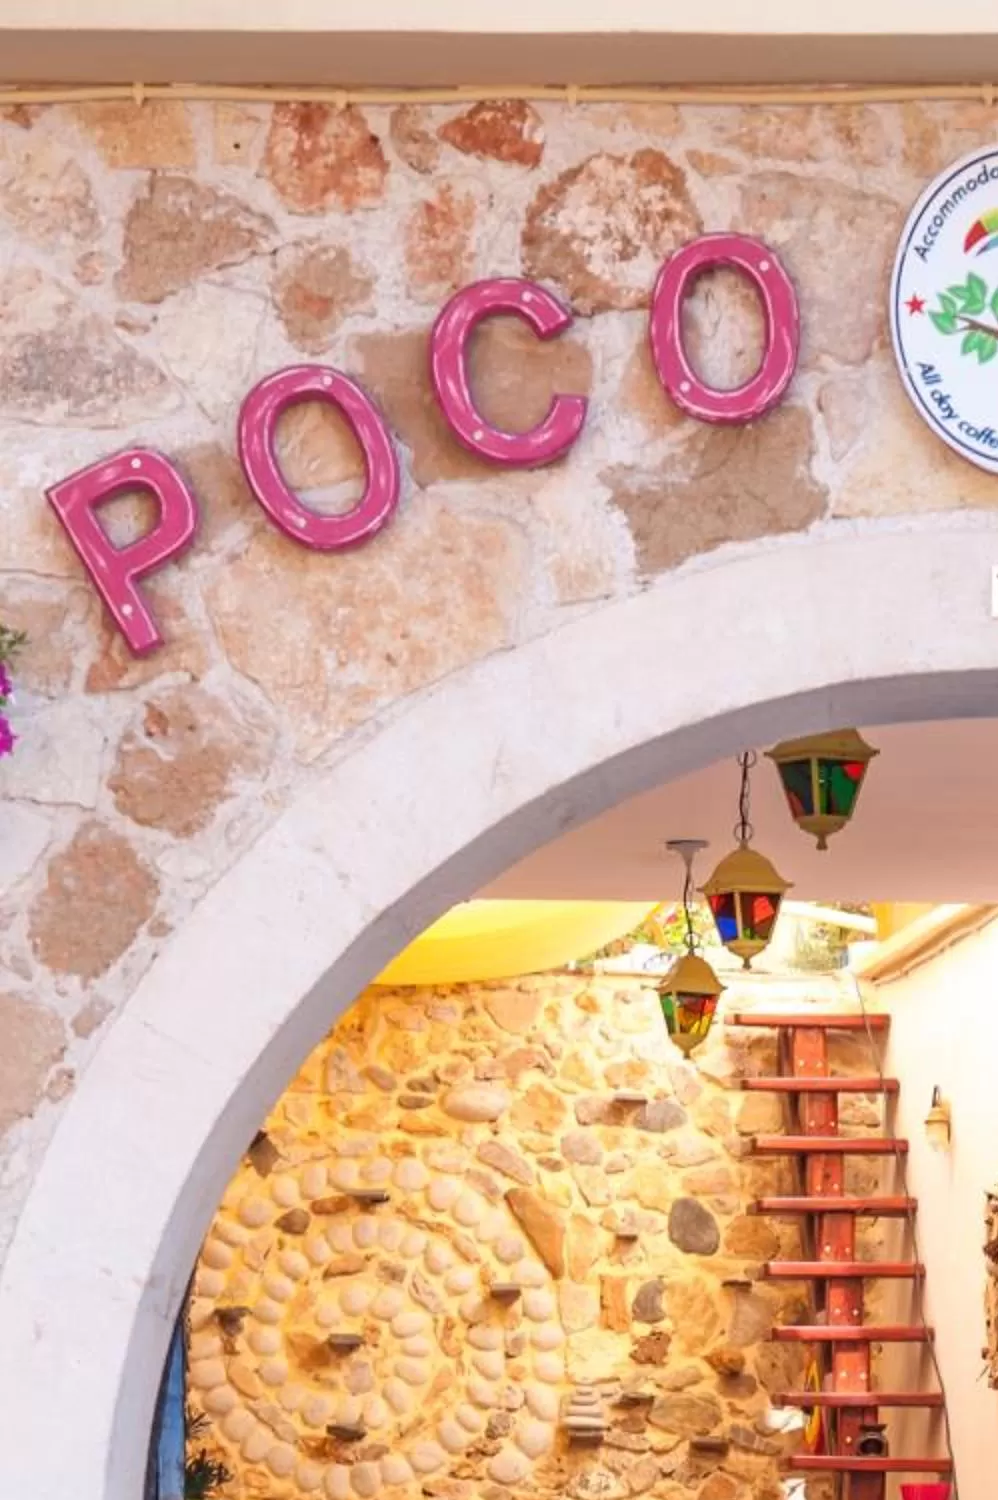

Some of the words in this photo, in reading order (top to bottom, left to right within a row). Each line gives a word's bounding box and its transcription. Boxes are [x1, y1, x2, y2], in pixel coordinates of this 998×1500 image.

[44, 231, 798, 657] POCO
[916, 361, 943, 385] All
[930, 389, 959, 419] day
